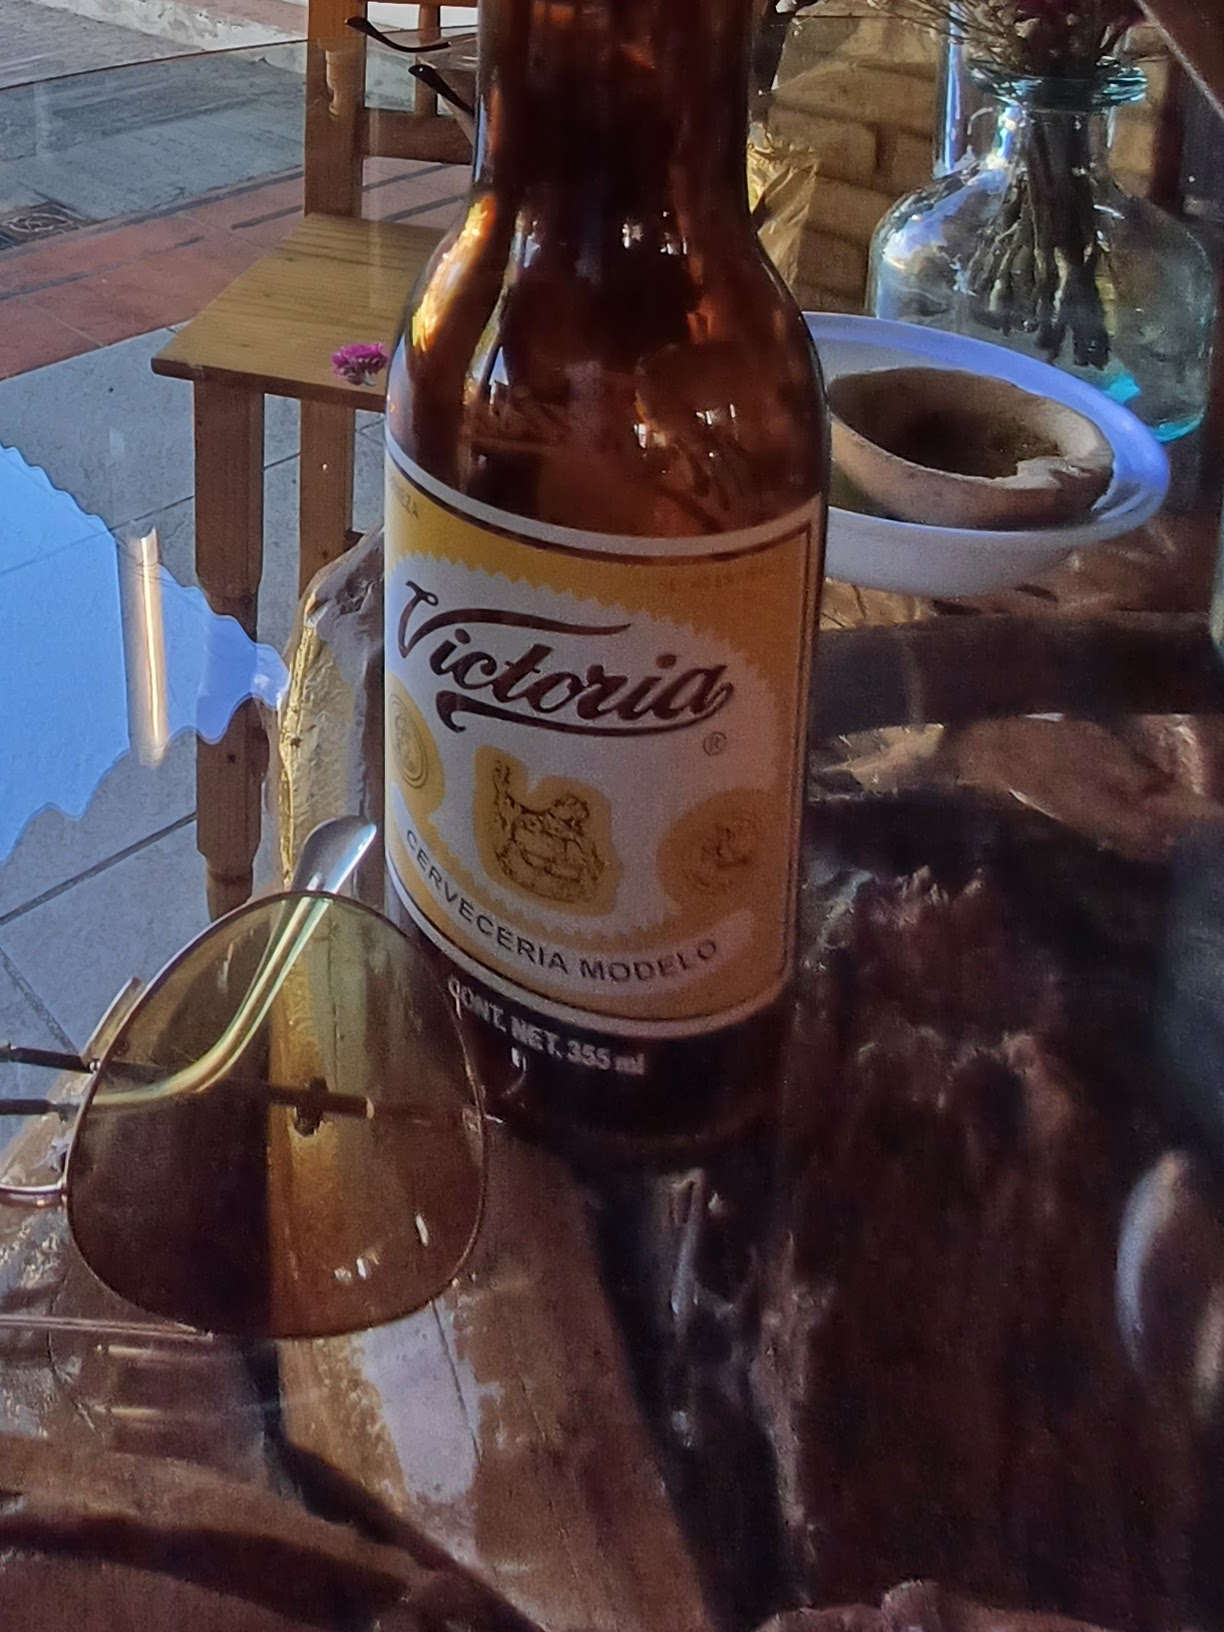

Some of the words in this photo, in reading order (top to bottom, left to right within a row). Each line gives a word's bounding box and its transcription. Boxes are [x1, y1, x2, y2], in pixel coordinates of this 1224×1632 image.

[398, 580, 735, 737] Victoria
[406, 829, 569, 974] CERVECERIA
[579, 939, 718, 984] MODELO
[567, 1039, 611, 1071] 355
